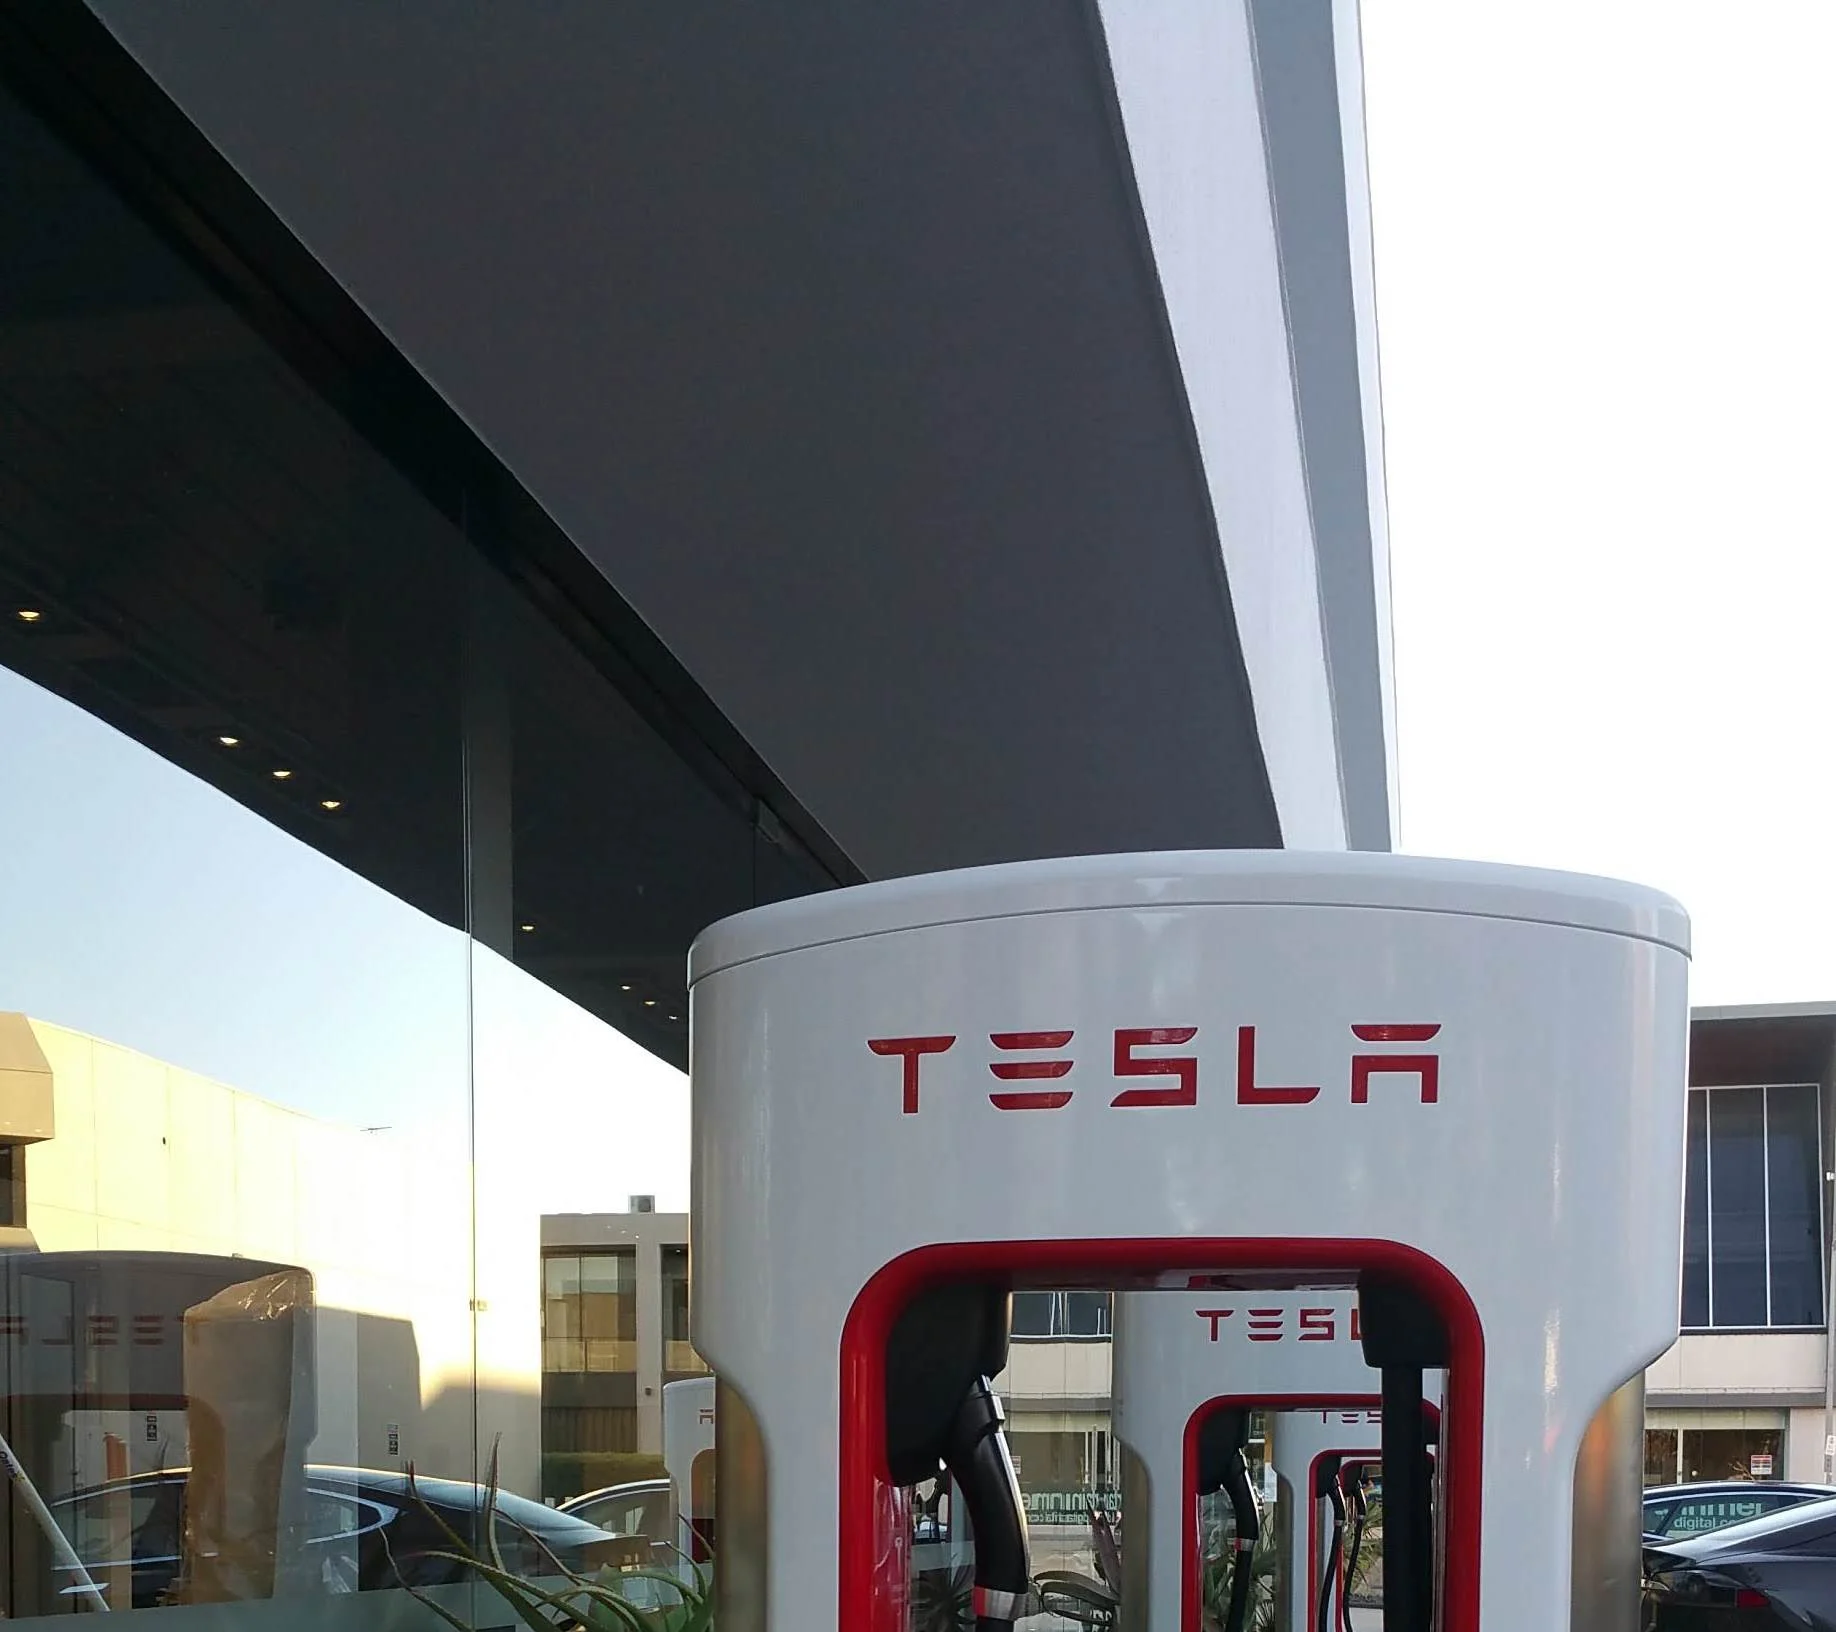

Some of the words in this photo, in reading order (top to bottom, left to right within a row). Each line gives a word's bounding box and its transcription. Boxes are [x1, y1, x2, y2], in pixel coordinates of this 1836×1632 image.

[867, 1023, 1442, 1114] TESLA
[1195, 1308, 1362, 1341] TESL
[1321, 1410, 1382, 1424] TES
